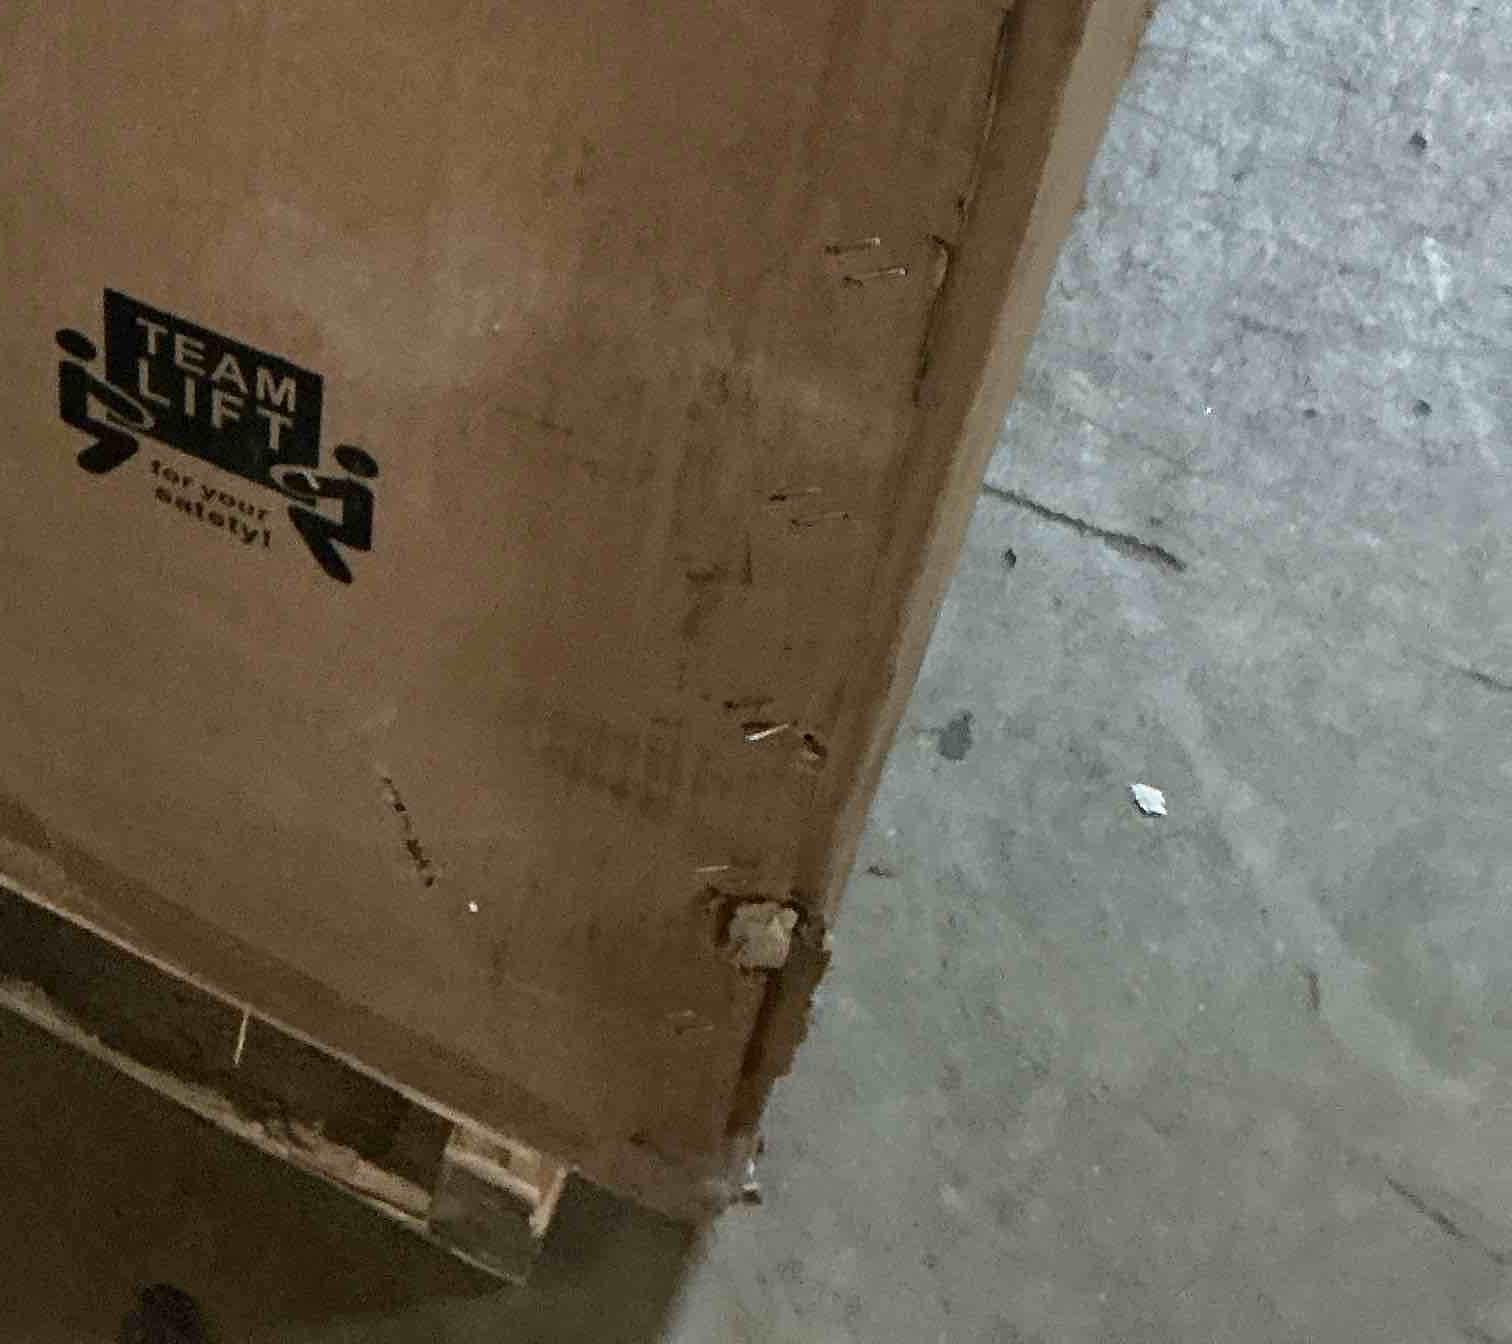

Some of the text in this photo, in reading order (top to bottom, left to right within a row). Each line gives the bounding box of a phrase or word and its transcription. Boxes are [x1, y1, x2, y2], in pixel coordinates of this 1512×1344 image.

[135, 316, 298, 413] TEAM
[138, 359, 295, 452] LIFT
[150, 459, 273, 522] for your
[154, 485, 273, 549] safety!
